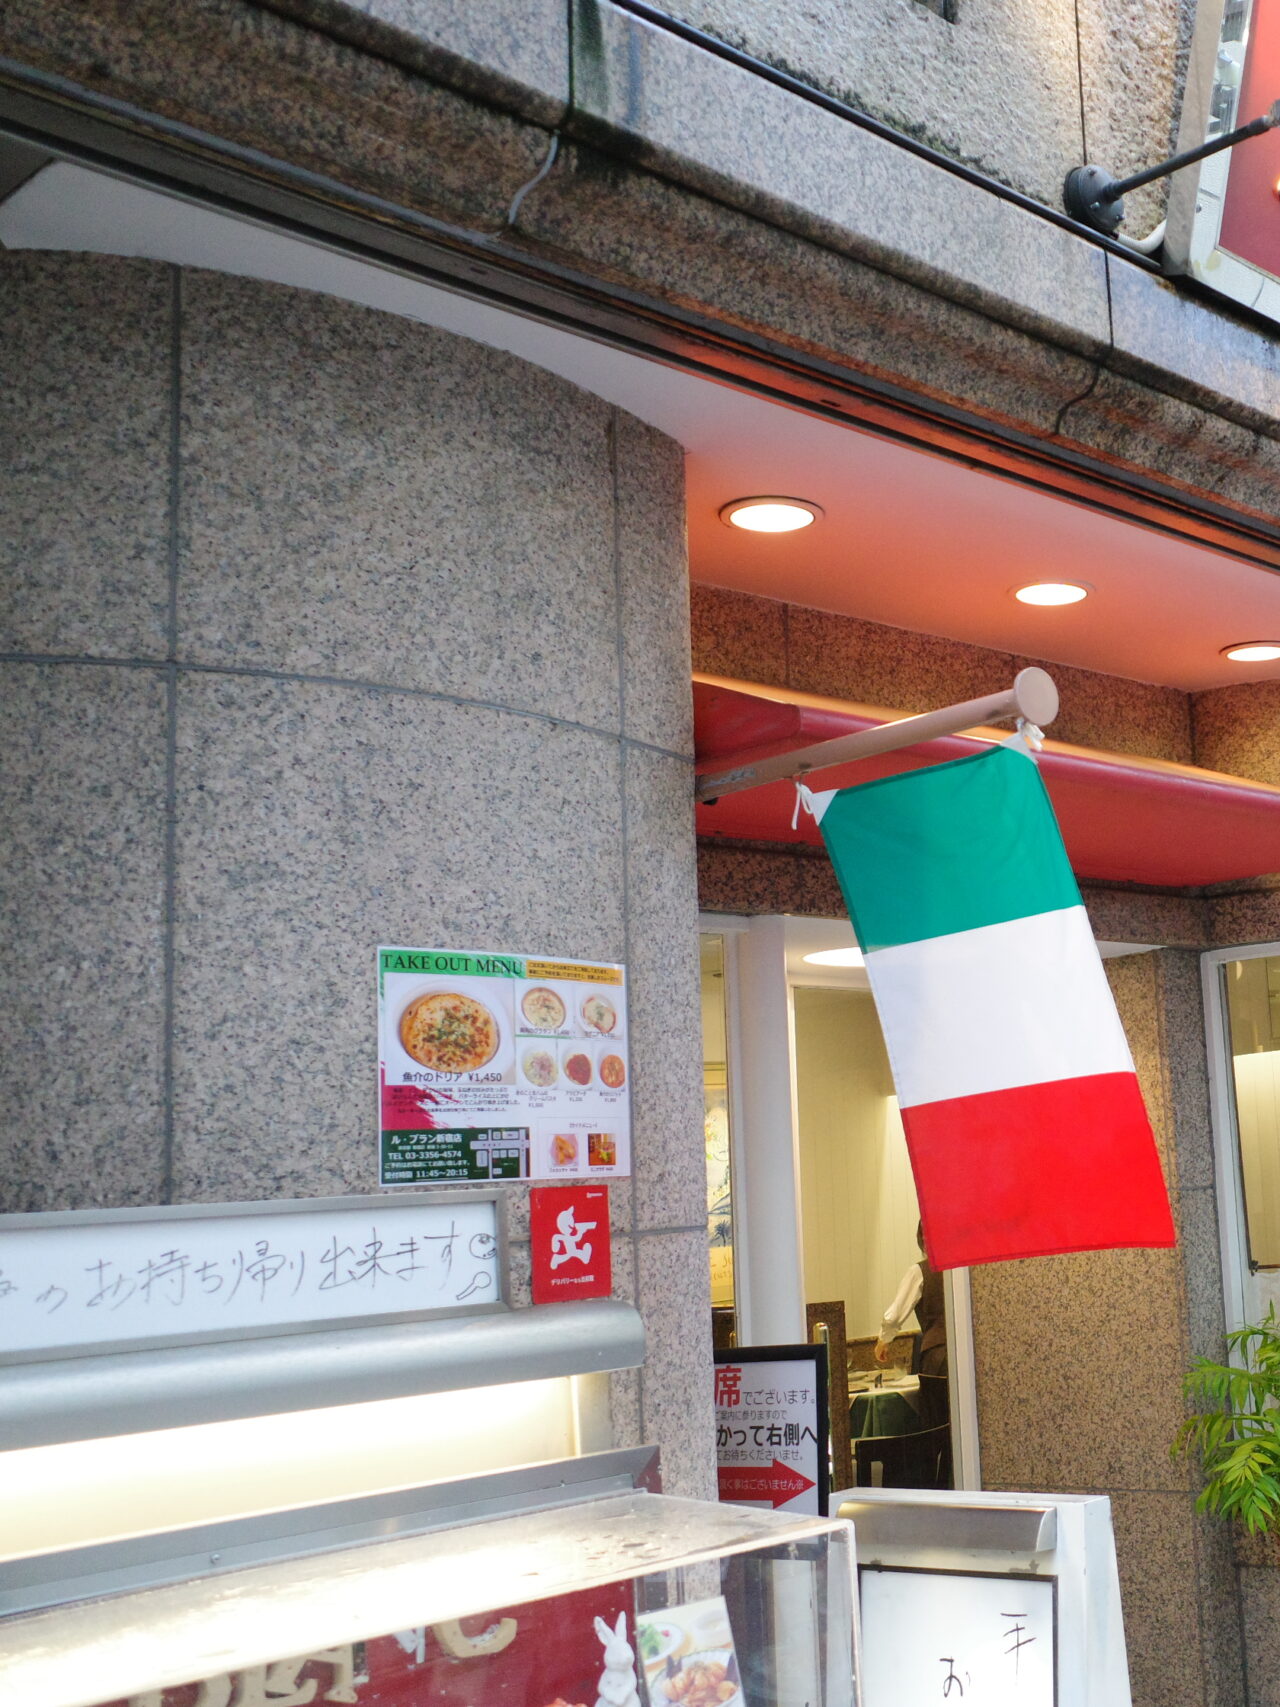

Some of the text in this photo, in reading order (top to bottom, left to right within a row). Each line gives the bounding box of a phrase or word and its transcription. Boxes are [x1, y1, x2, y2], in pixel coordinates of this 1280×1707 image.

[381, 953, 430, 970] TAKE
[434, 956, 471, 972] OUT
[476, 958, 524, 975] MENU
[717, 1422, 818, 1447] かって右側へ
